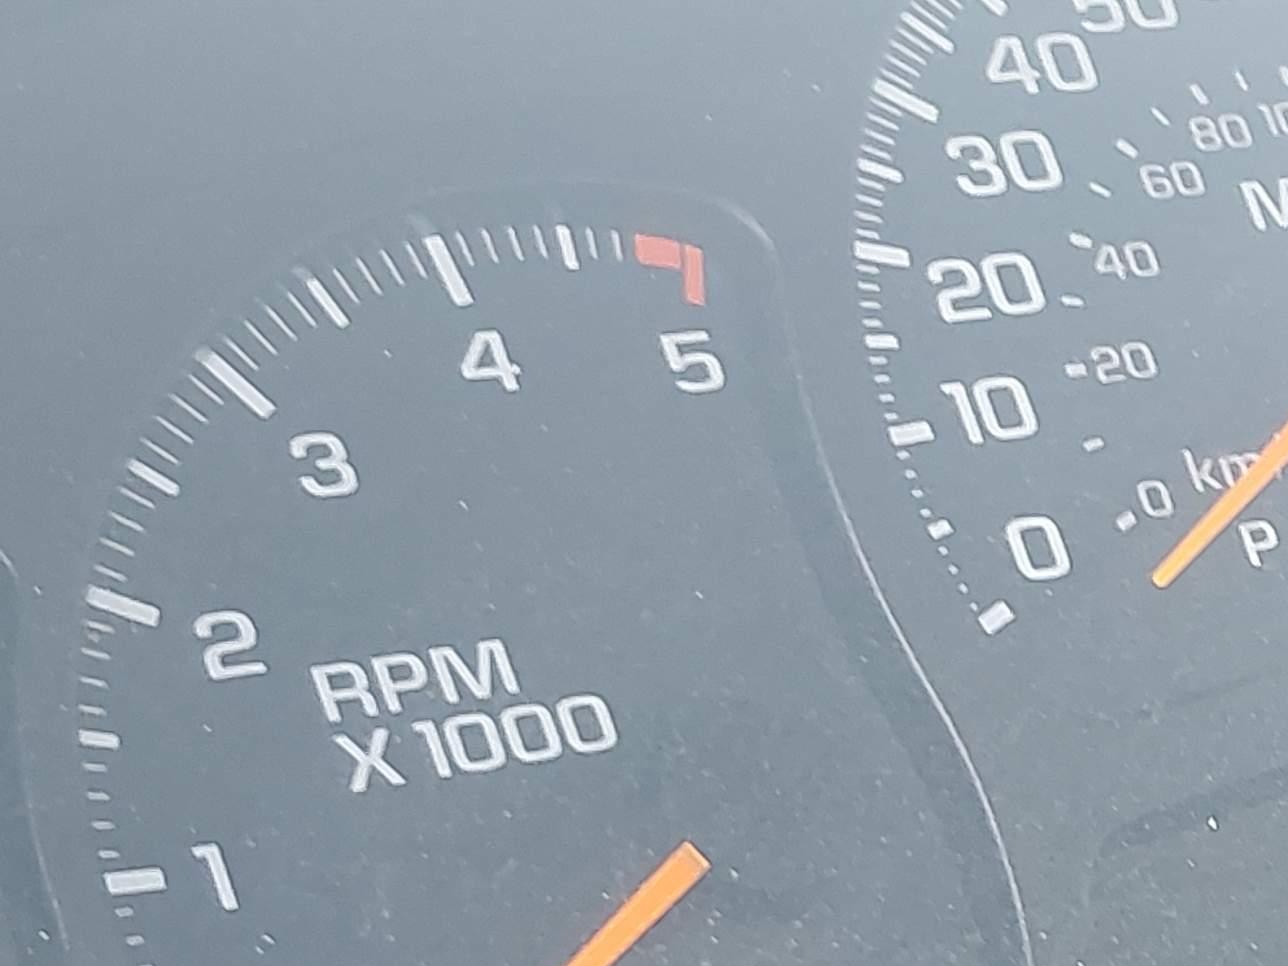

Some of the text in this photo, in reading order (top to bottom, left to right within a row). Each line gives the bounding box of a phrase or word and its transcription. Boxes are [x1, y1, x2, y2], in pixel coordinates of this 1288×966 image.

[986, 31, 1098, 94] 40
[945, 130, 1062, 196] 30
[1189, 113, 1253, 151] 80
[1139, 161, 1205, 198] 60
[927, 252, 1046, 323] 20
[1096, 241, 1159, 278] 40
[460, 329, 520, 391] 4
[659, 329, 725, 393] 5
[1091, 342, 1158, 382] 20
[939, 376, 1038, 444] 10
[287, 432, 358, 497] 3
[1137, 480, 1173, 516] 0
[1005, 515, 1071, 580] 0
[1239, 519, 1278, 566] P
[194, 609, 266, 680] 2
[310, 638, 519, 722] RPM
[332, 694, 618, 791] X 1000
[191, 842, 239, 910] 1
